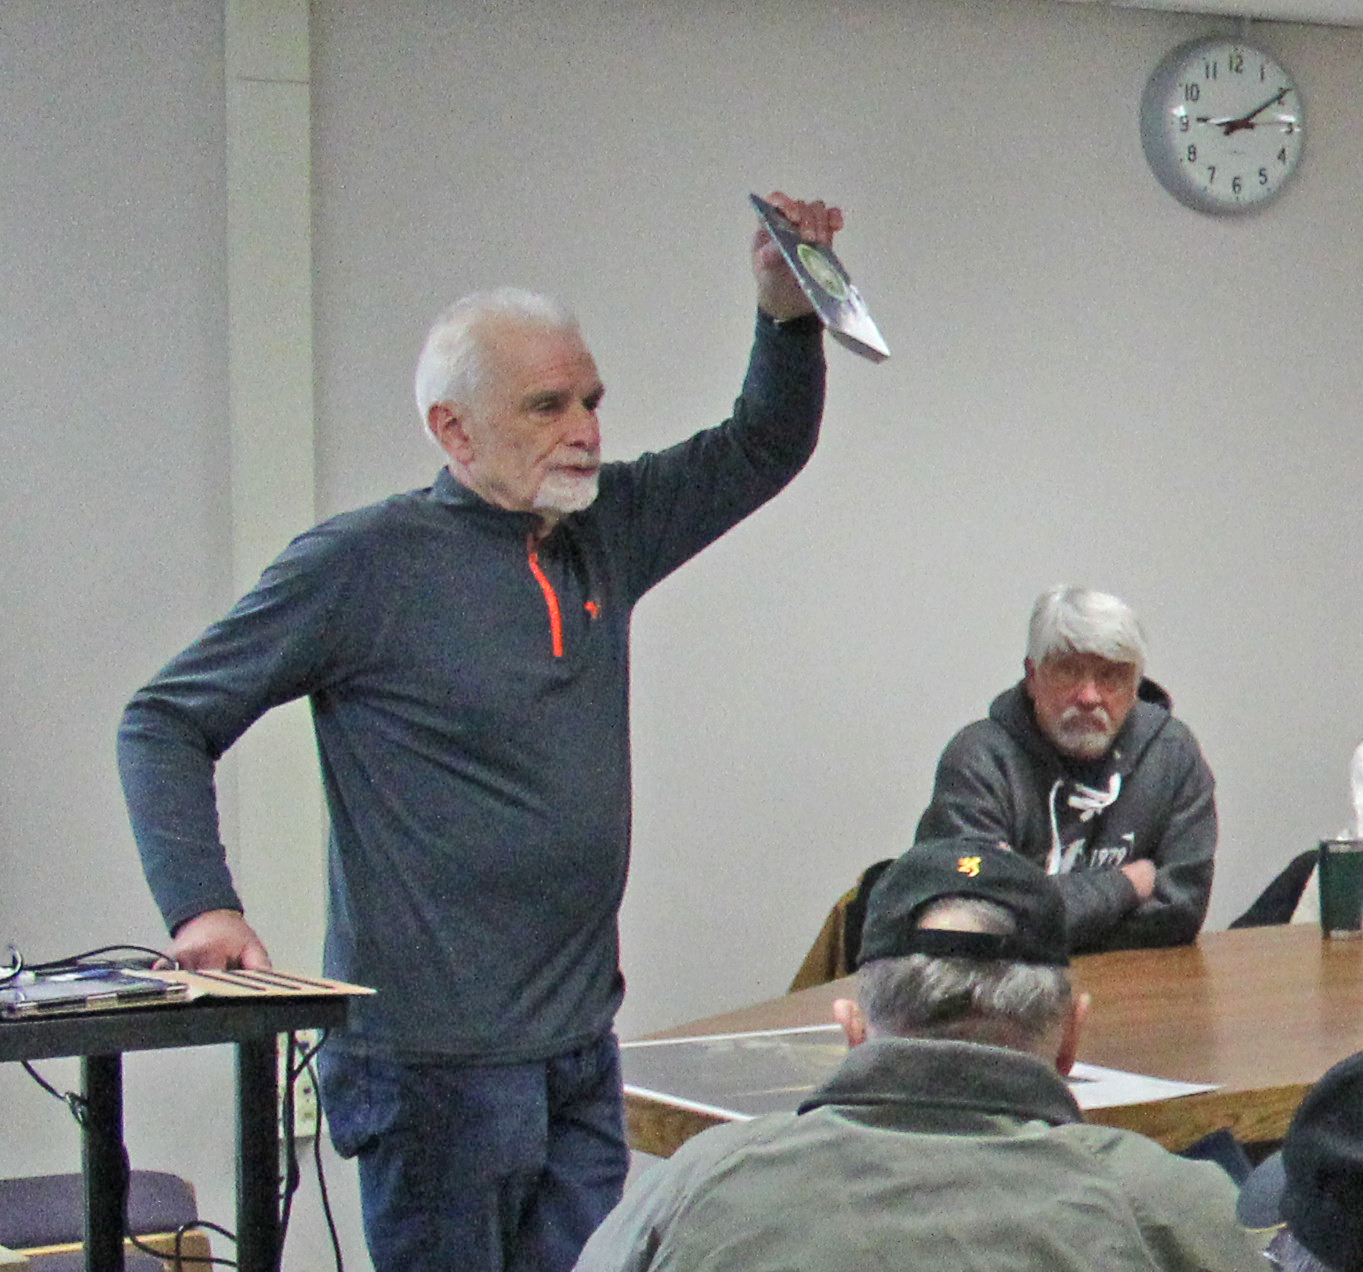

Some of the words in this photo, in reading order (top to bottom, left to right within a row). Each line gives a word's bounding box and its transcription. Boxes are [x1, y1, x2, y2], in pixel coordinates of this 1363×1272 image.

[1205, 61, 1217, 80] 11
[1229, 52, 1244, 73] 12
[1260, 64, 1265, 81] 1
[1185, 83, 1200, 101] 10
[1179, 115, 1189, 132] 9
[1187, 144, 1197, 163] 8
[1278, 148, 1286, 165] 4
[1208, 166, 1216, 183] 7
[1259, 168, 1268, 185] 5
[1232, 176, 1242, 193] 6
